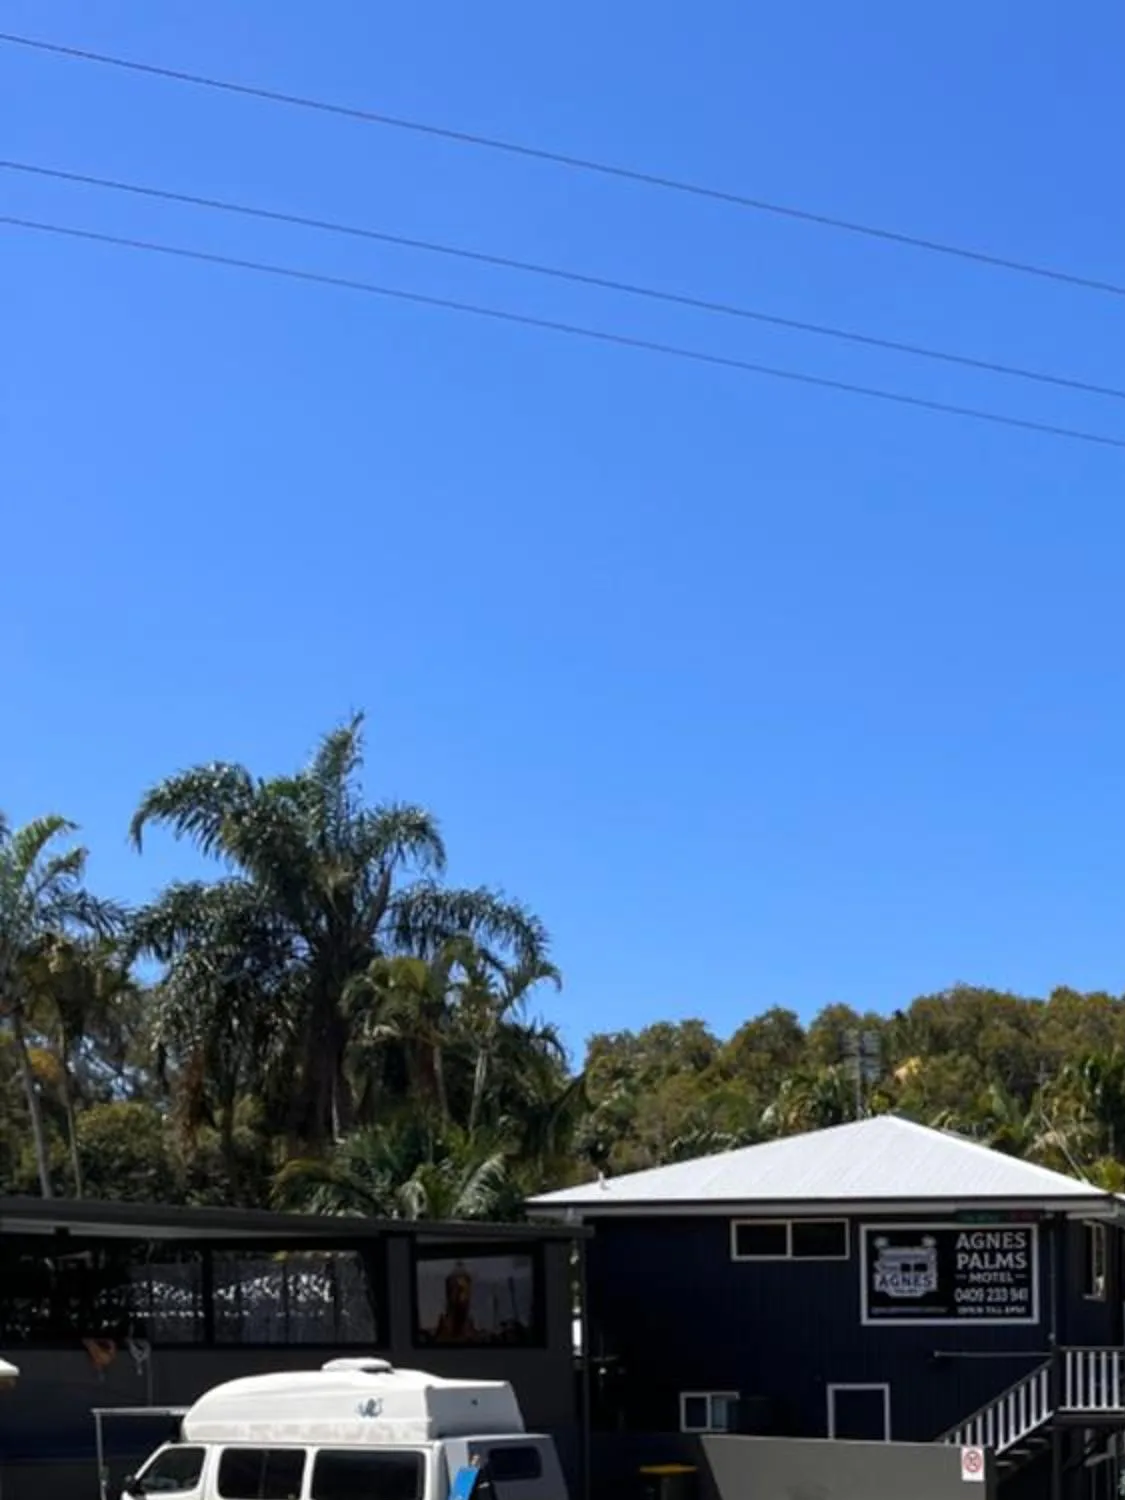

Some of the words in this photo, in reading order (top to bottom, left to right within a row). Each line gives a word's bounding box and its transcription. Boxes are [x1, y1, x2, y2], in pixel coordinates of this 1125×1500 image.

[955, 1231, 1027, 1249] AGNES
[957, 1252, 1028, 1269] PALMS
[879, 1272, 933, 1286] AGNES
[968, 1272, 1014, 1283] MOTEL
